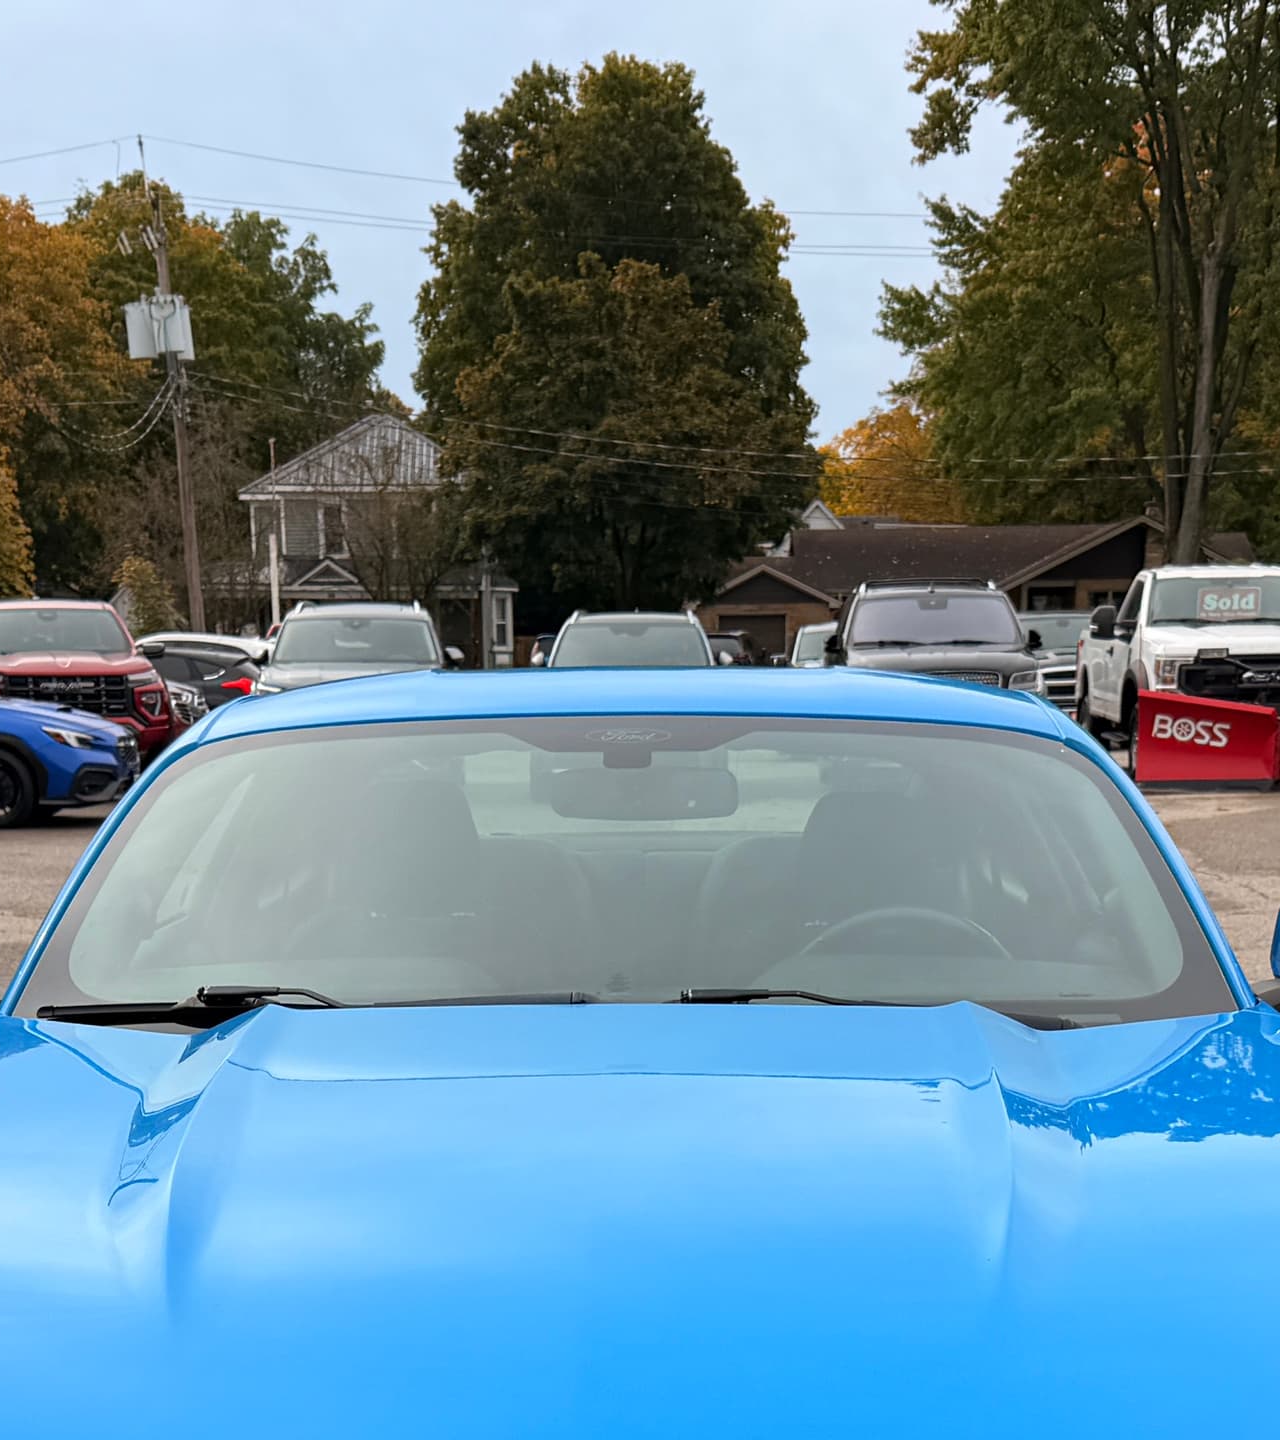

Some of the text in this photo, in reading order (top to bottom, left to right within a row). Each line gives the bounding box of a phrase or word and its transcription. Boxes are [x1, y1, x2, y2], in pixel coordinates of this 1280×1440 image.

[1203, 592, 1255, 611] Sold
[600, 730, 657, 742] Ford
[1152, 714, 1231, 747] BOSS
